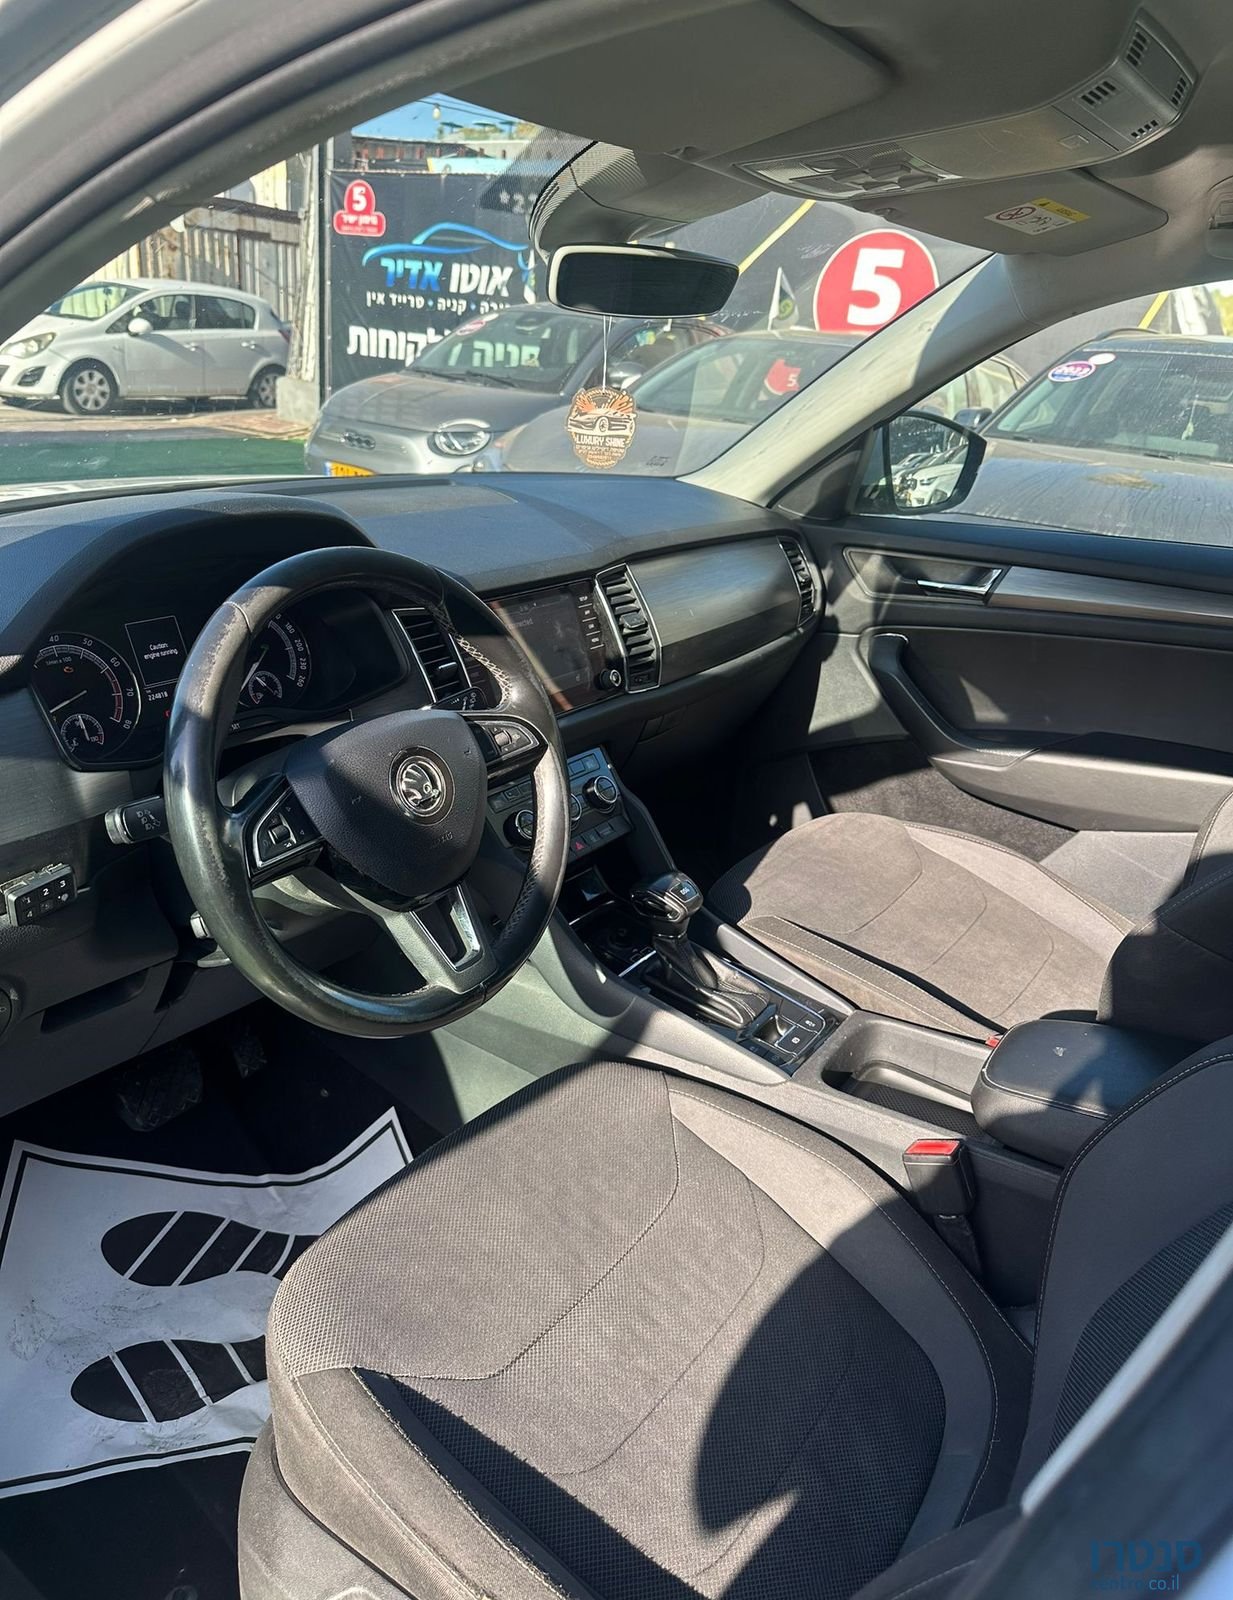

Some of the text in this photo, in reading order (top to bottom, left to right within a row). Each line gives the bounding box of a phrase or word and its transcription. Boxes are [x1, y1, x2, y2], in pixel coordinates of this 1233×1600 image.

[352, 186, 367, 212] 5
[380, 257, 514, 297] אוטו אדיר
[847, 247, 906, 326] 5
[366, 290, 386, 307] אין
[437, 297, 467, 316] קניה
[786, 373, 798, 388] 5
[576, 434, 626, 448] LUXURY SHINE
[49, 634, 60, 643] 40
[82, 637, 93, 647] 50
[294, 638, 304, 652] 200
[110, 657, 121, 668] 60
[126, 687, 135, 697] 70
[122, 719, 132, 730] 80
[43, 887, 49, 896] 2
[60, 880, 66, 888] 3
[27, 910, 33, 918] 4
